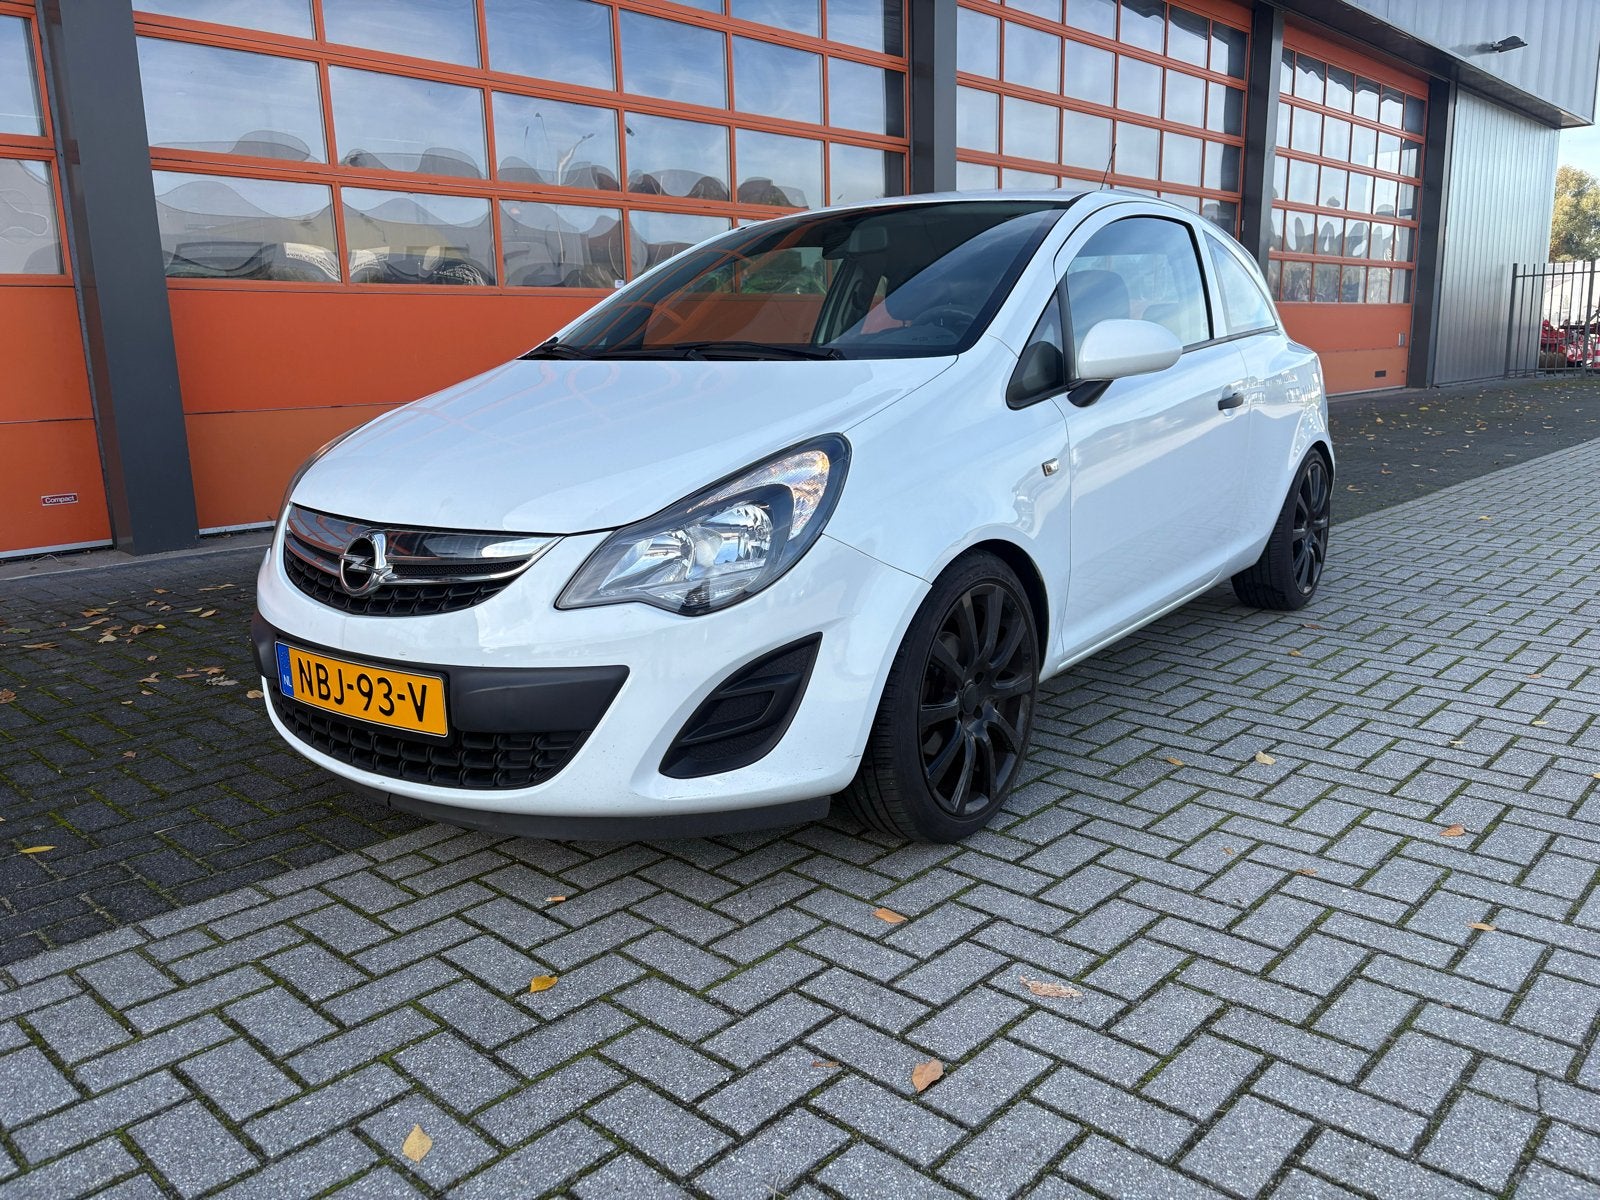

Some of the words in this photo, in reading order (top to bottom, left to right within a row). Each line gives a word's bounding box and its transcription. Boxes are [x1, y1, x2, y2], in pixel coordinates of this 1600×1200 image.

[45, 495, 75, 504] Compact
[283, 674, 292, 688] NL
[298, 657, 427, 722] NBJ-93-V
